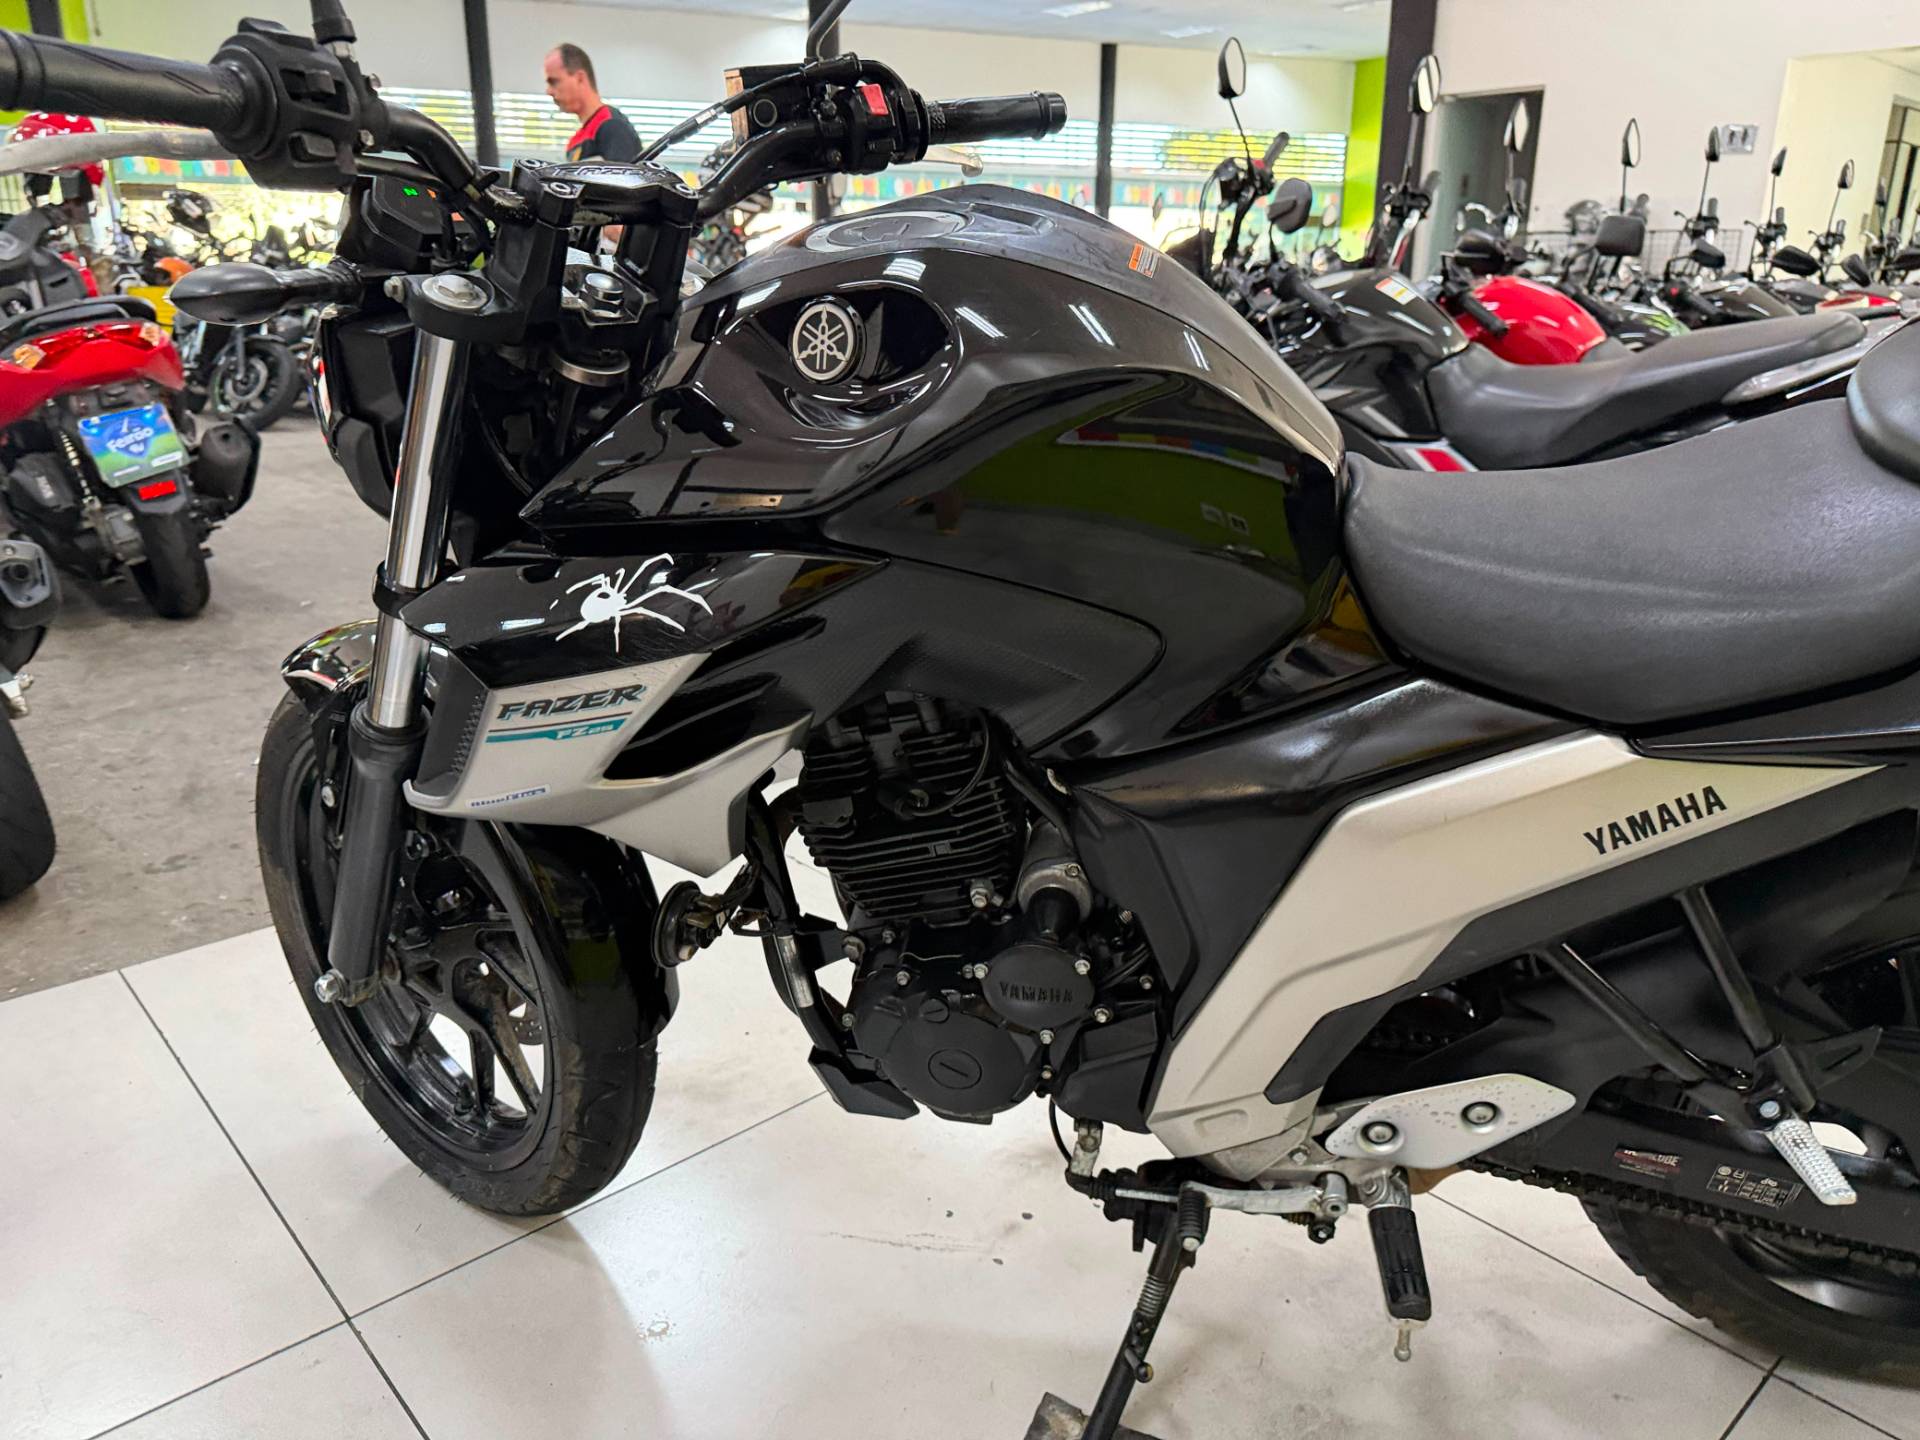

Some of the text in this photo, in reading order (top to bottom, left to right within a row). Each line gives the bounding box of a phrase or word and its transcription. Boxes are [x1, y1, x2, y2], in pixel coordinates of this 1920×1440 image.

[497, 684, 647, 721] FAZER
[1583, 785, 1728, 855] YAMAHA
[1000, 982, 1073, 1002] YAMAHA
